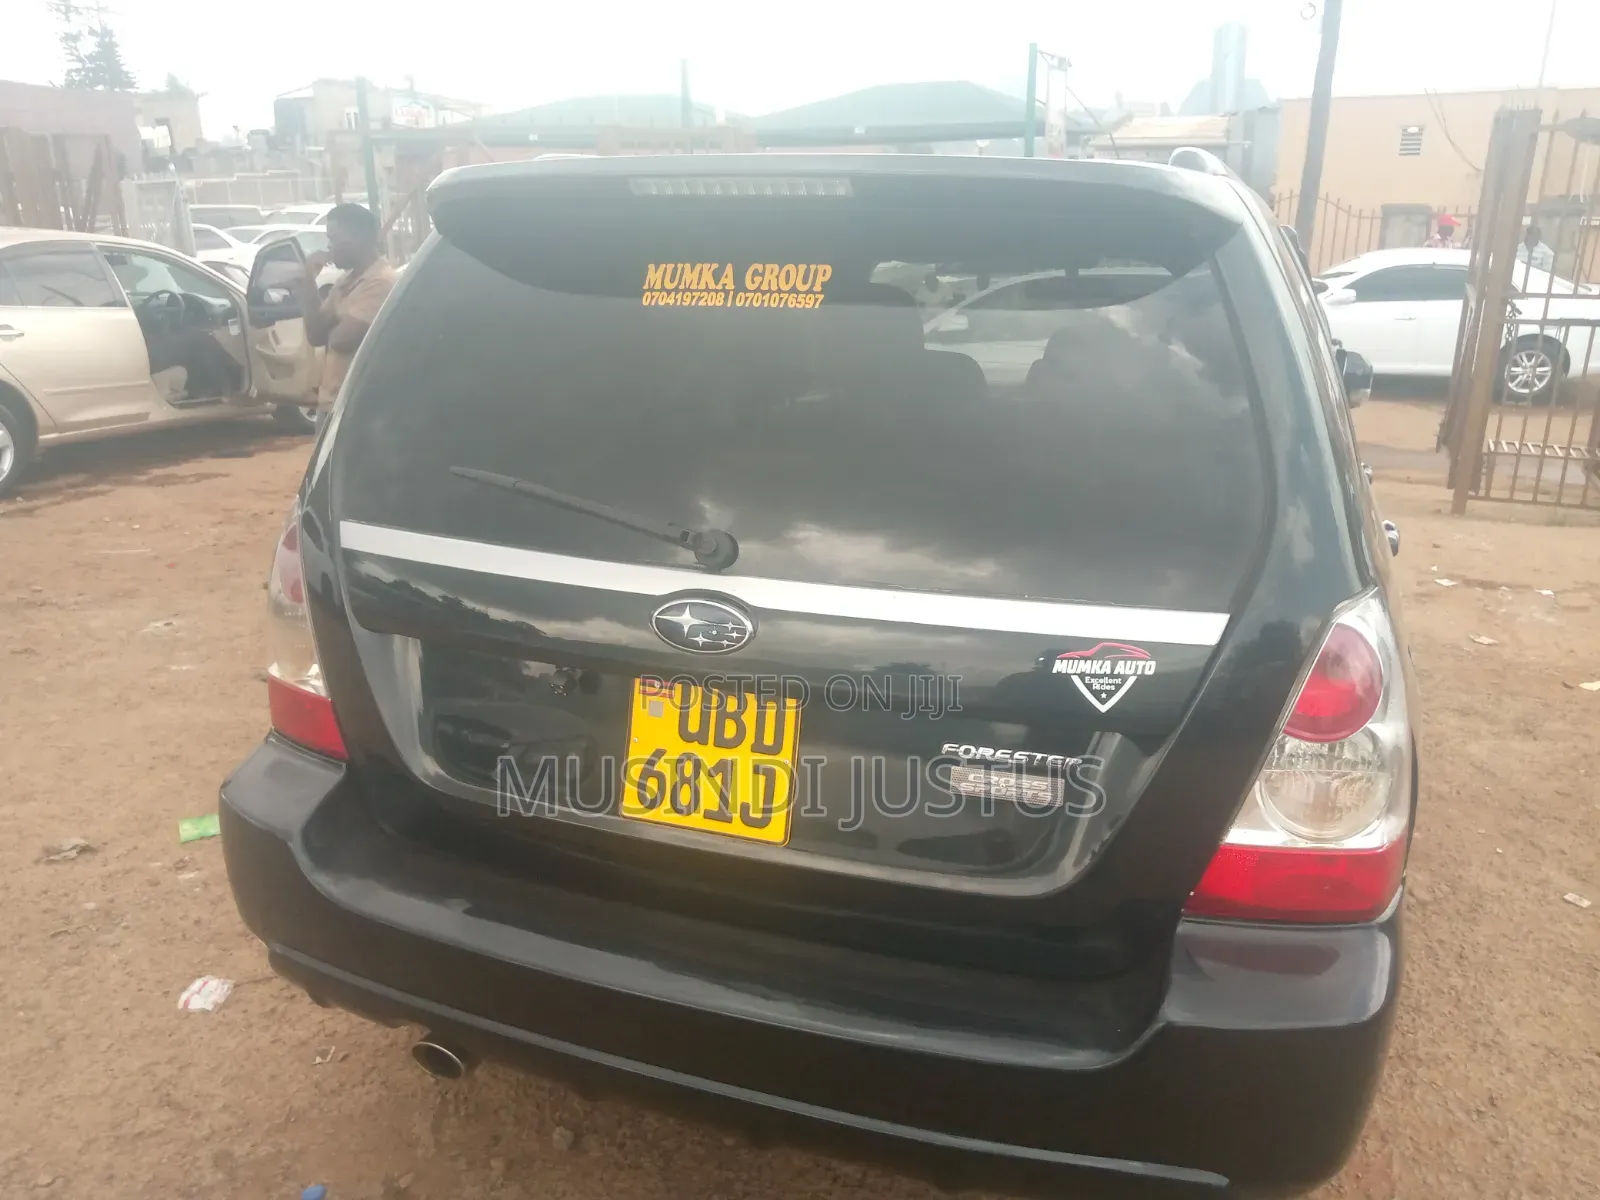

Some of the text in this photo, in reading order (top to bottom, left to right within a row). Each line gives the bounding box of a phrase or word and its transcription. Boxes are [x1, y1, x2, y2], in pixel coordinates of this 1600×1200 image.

[643, 263, 832, 291] MUMKA GROUP
[642, 291, 724, 306] 0704197208
[735, 292, 824, 308] 0701076597
[1052, 659, 1156, 675] MUMKA AUTO
[1084, 676, 1122, 684] Excellent
[941, 743, 1083, 770] FORESTER
[636, 748, 776, 829] 681J
